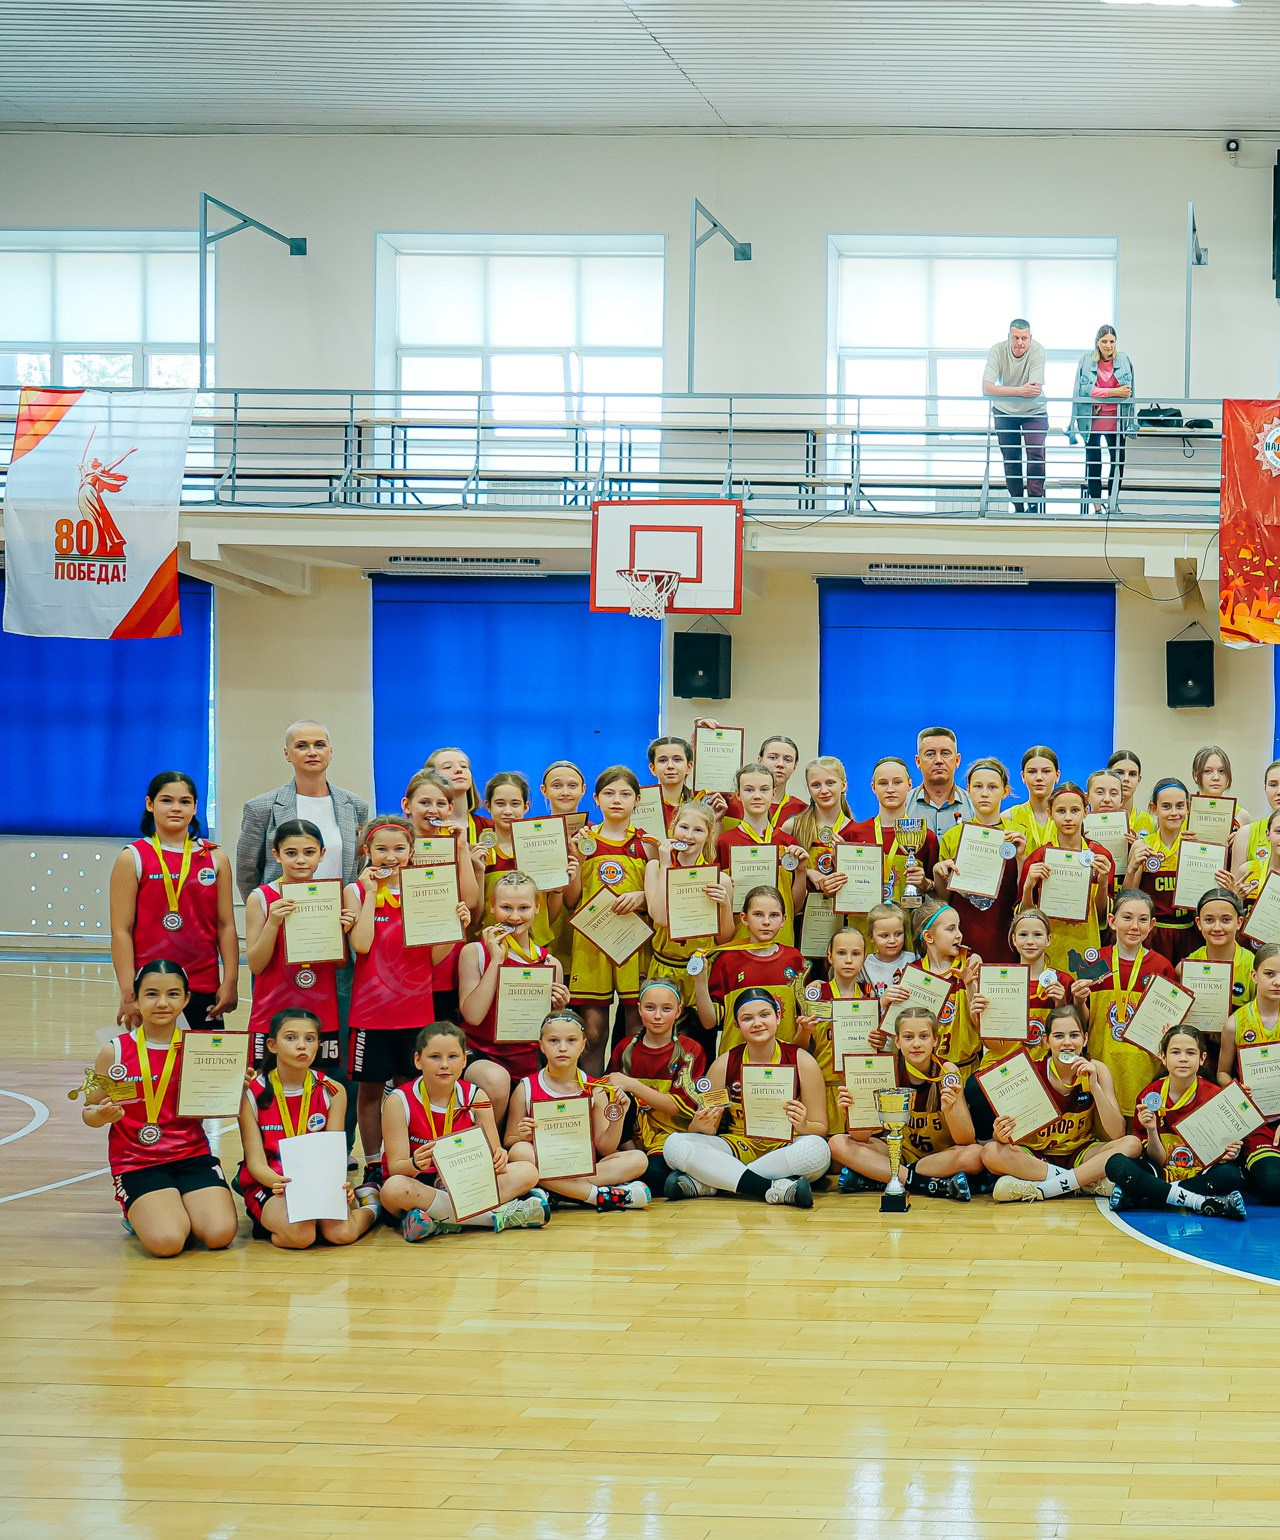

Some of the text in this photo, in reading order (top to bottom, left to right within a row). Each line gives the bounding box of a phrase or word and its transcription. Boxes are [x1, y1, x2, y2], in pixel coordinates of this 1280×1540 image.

[55, 518, 95, 555] 80
[54, 561, 127, 585] ПОБЕДА!
[523, 838, 558, 849] ДИПЛОМ
[967, 845, 999, 855] ДИПЛОМ
[739, 865, 770, 873] ДИПЛОМ
[844, 864, 875, 872] ДИПЛОМ
[1186, 860, 1217, 870] ДИПЛОМ
[1051, 869, 1083, 878] ДИПЛОМ
[412, 887, 450, 898] ДИПЛОМ
[676, 886, 706, 895] ДИПЛО
[590, 909, 614, 931] ДИПЛО
[987, 987, 1020, 995] ДИПЛОМ
[1190, 982, 1223, 990] ДИПЛОМ
[508, 988, 544, 996] ДИПЛОМ
[1152, 997, 1179, 1017] ДИПЛОМ
[841, 1020, 872, 1028] ДИПЛОМ
[255, 1033, 265, 1060] ИМПУ
[320, 1040, 339, 1059] 15
[193, 1057, 237, 1065] ДИПЛОМ
[853, 1077, 888, 1085] ДИПЛОМ
[751, 1087, 785, 1096] ДИПЛОМ
[997, 1075, 1030, 1099] ДИПЛОМ
[1217, 1101, 1243, 1133] ДИПЛОМ
[544, 1120, 582, 1131] ДИПЛОМ
[932, 1118, 942, 1131] 5
[1077, 1117, 1085, 1130] 5
[448, 1151, 484, 1168] ДИПЛОМ
